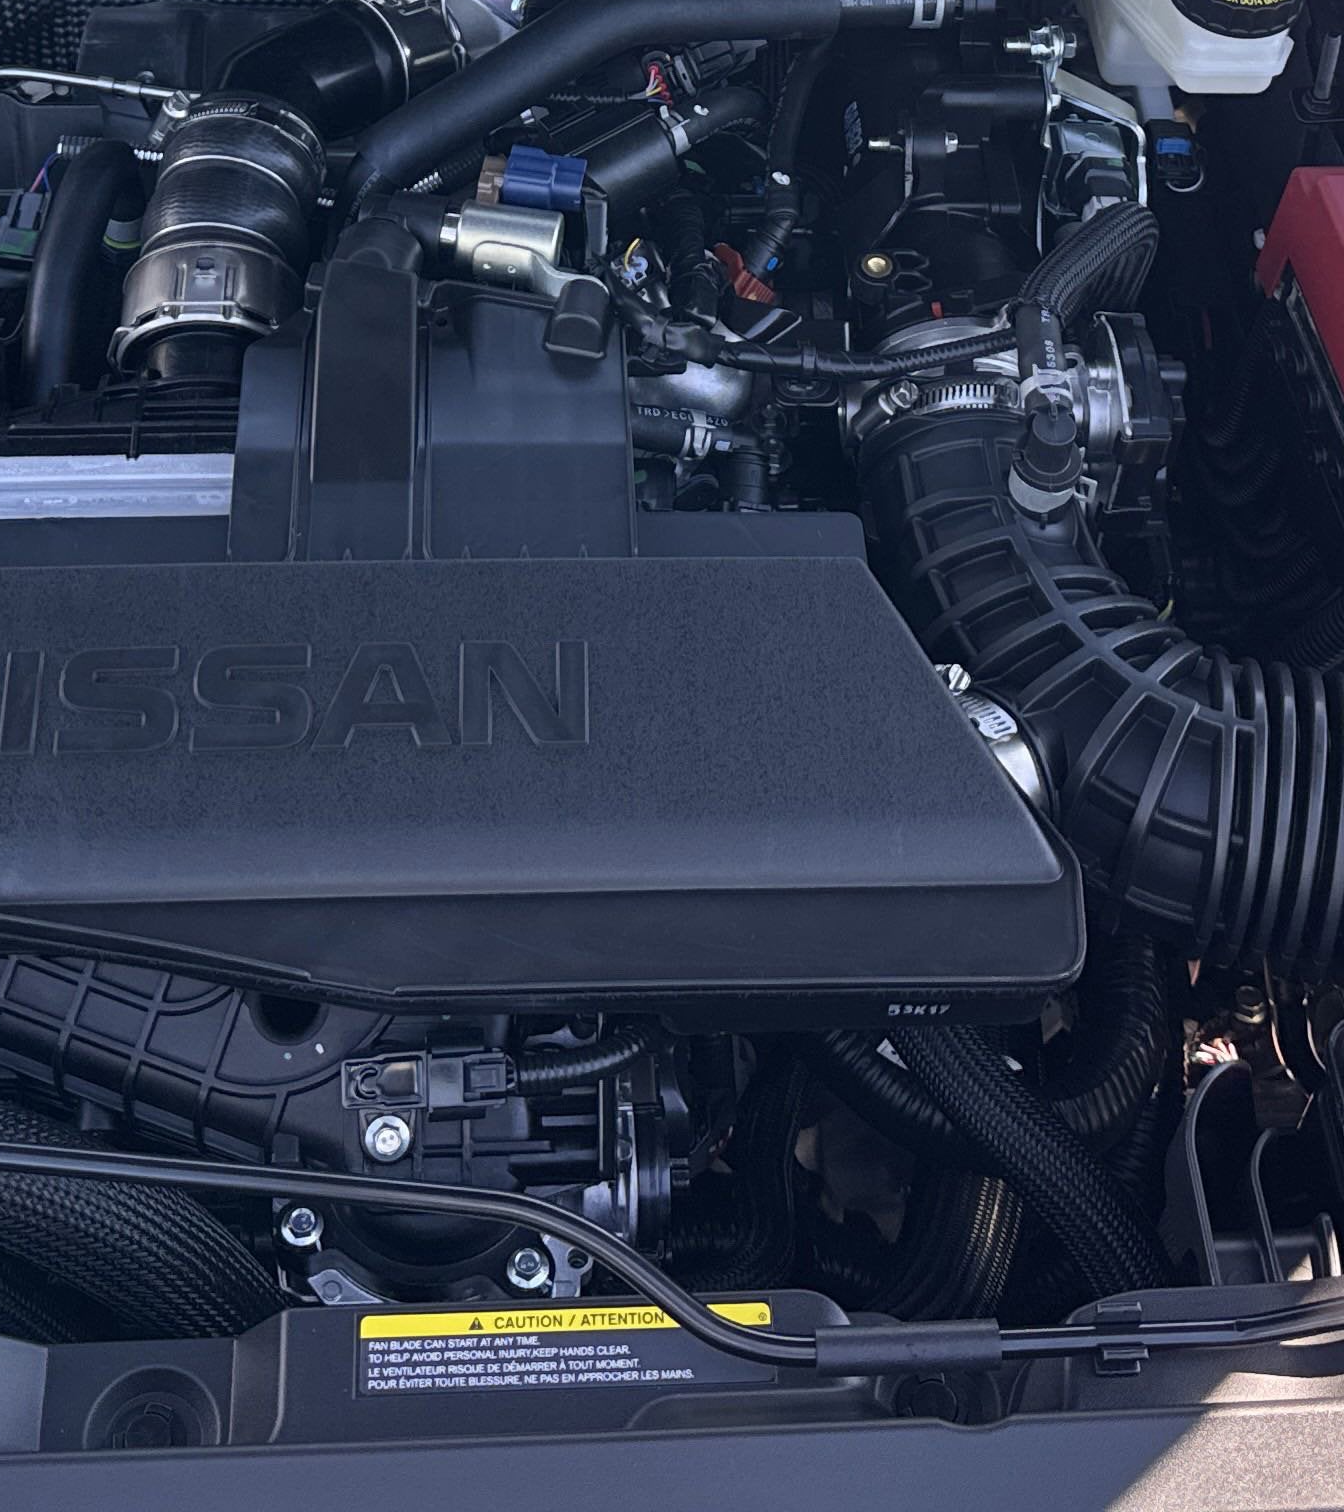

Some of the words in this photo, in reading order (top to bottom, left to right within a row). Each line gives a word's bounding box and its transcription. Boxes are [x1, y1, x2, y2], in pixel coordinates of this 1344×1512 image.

[637, 406, 661, 417] TRD
[494, 1314, 563, 1329] CAUTION
[581, 1312, 665, 1327] ATTENTION
[369, 1341, 388, 1351] FAN
[390, 1340, 422, 1350] BLADE
[424, 1339, 446, 1349] CAN
[447, 1338, 478, 1348] START
[480, 1337, 492, 1347] AT
[493, 1336, 515, 1346] ANY
[516, 1335, 540, 1346] TIME.
[369, 1353, 383, 1363] TO
[385, 1352, 411, 1363] HELP
[411, 1351, 442, 1362] AVOID
[444, 1349, 497, 1361] PERSONAL
[560, 1346, 594, 1356] HANDS
[597, 1345, 631, 1355] CLEAR.
[369, 1367, 381, 1378] LE
[382, 1365, 446, 1376] VENTILATEUR
[447, 1363, 486, 1375] RISQUE
[487, 1363, 501, 1373] DE
[503, 1360, 557, 1372] DÉMARRER
[559, 1359, 567, 1369] À
[568, 1360, 594, 1369] TOUT
[596, 1358, 641, 1368] MOMENT.
[368, 1379, 397, 1389] POUR
[399, 1377, 432, 1388] ÉVITER
[435, 1378, 467, 1387] TOUTE
[468, 1376, 522, 1387] BLESSURE,
[524, 1375, 539, 1385] NE
[540, 1374, 560, 1384] PAS
[562, 1373, 576, 1383] EN
[577, 1370, 640, 1382] APPROCHER
[641, 1370, 659, 1380] LES
[661, 1368, 694, 1379] MAINS.
